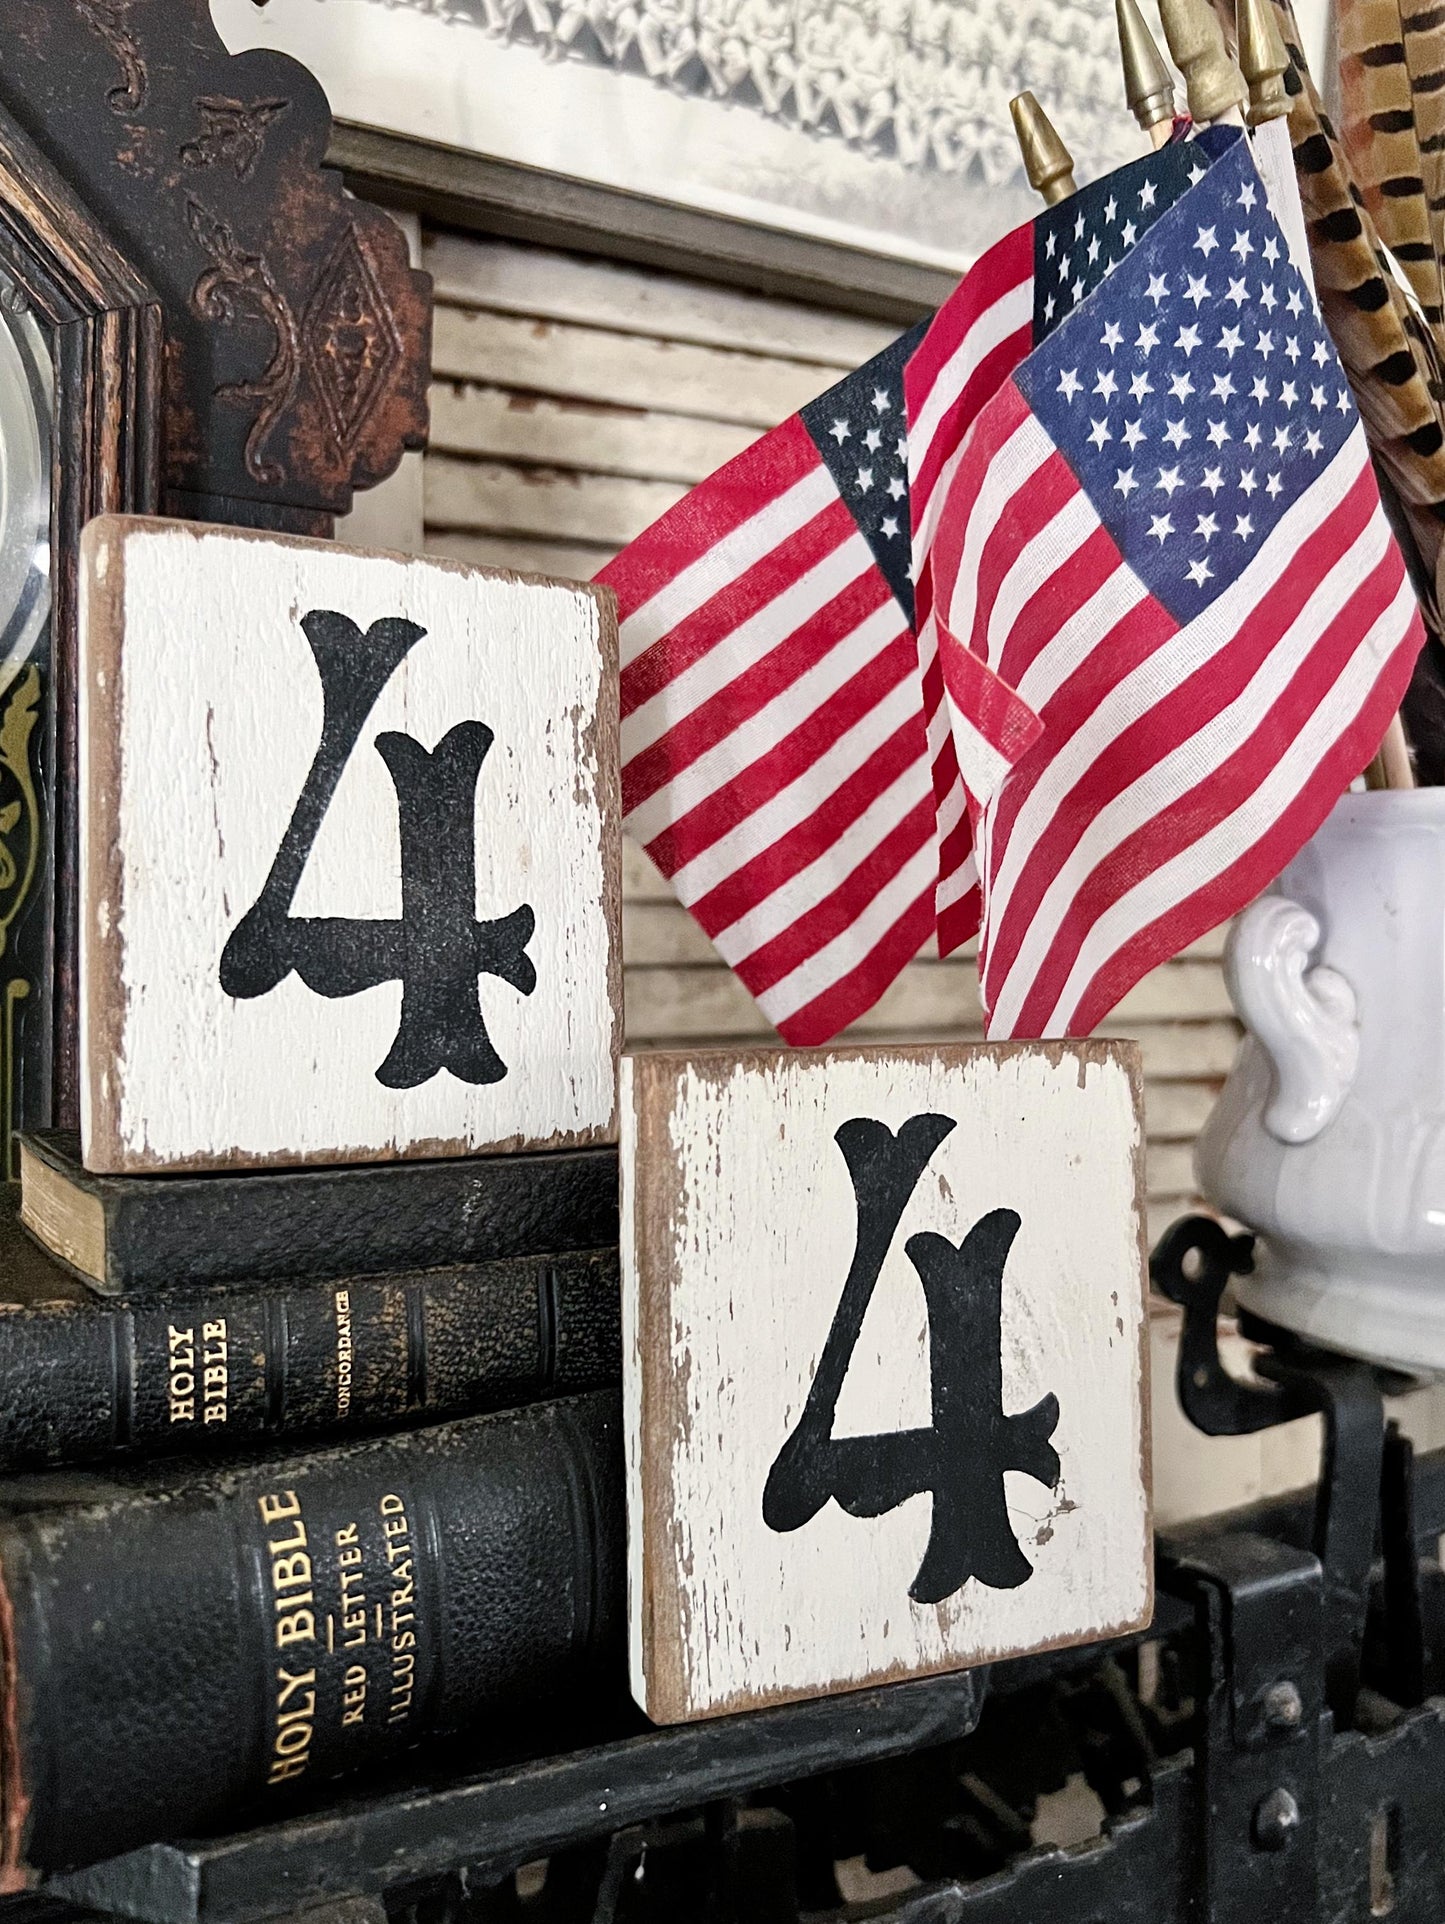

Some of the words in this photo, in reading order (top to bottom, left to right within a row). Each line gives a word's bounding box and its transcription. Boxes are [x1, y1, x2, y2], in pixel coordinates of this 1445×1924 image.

[221, 609, 537, 1090] 4
[168, 1325, 194, 1423] HOLY
[202, 1318, 228, 1425] BIBLE
[335, 1290, 351, 1418] CONCORDANCE
[763, 1113, 1060, 1606] 4
[258, 1490, 317, 1648] BIBLE
[336, 1522, 367, 1648] LETTER
[380, 1493, 416, 1724] ILLUSTRATED
[267, 1667, 316, 1785] HOLY
[341, 1664, 367, 1728] RED
